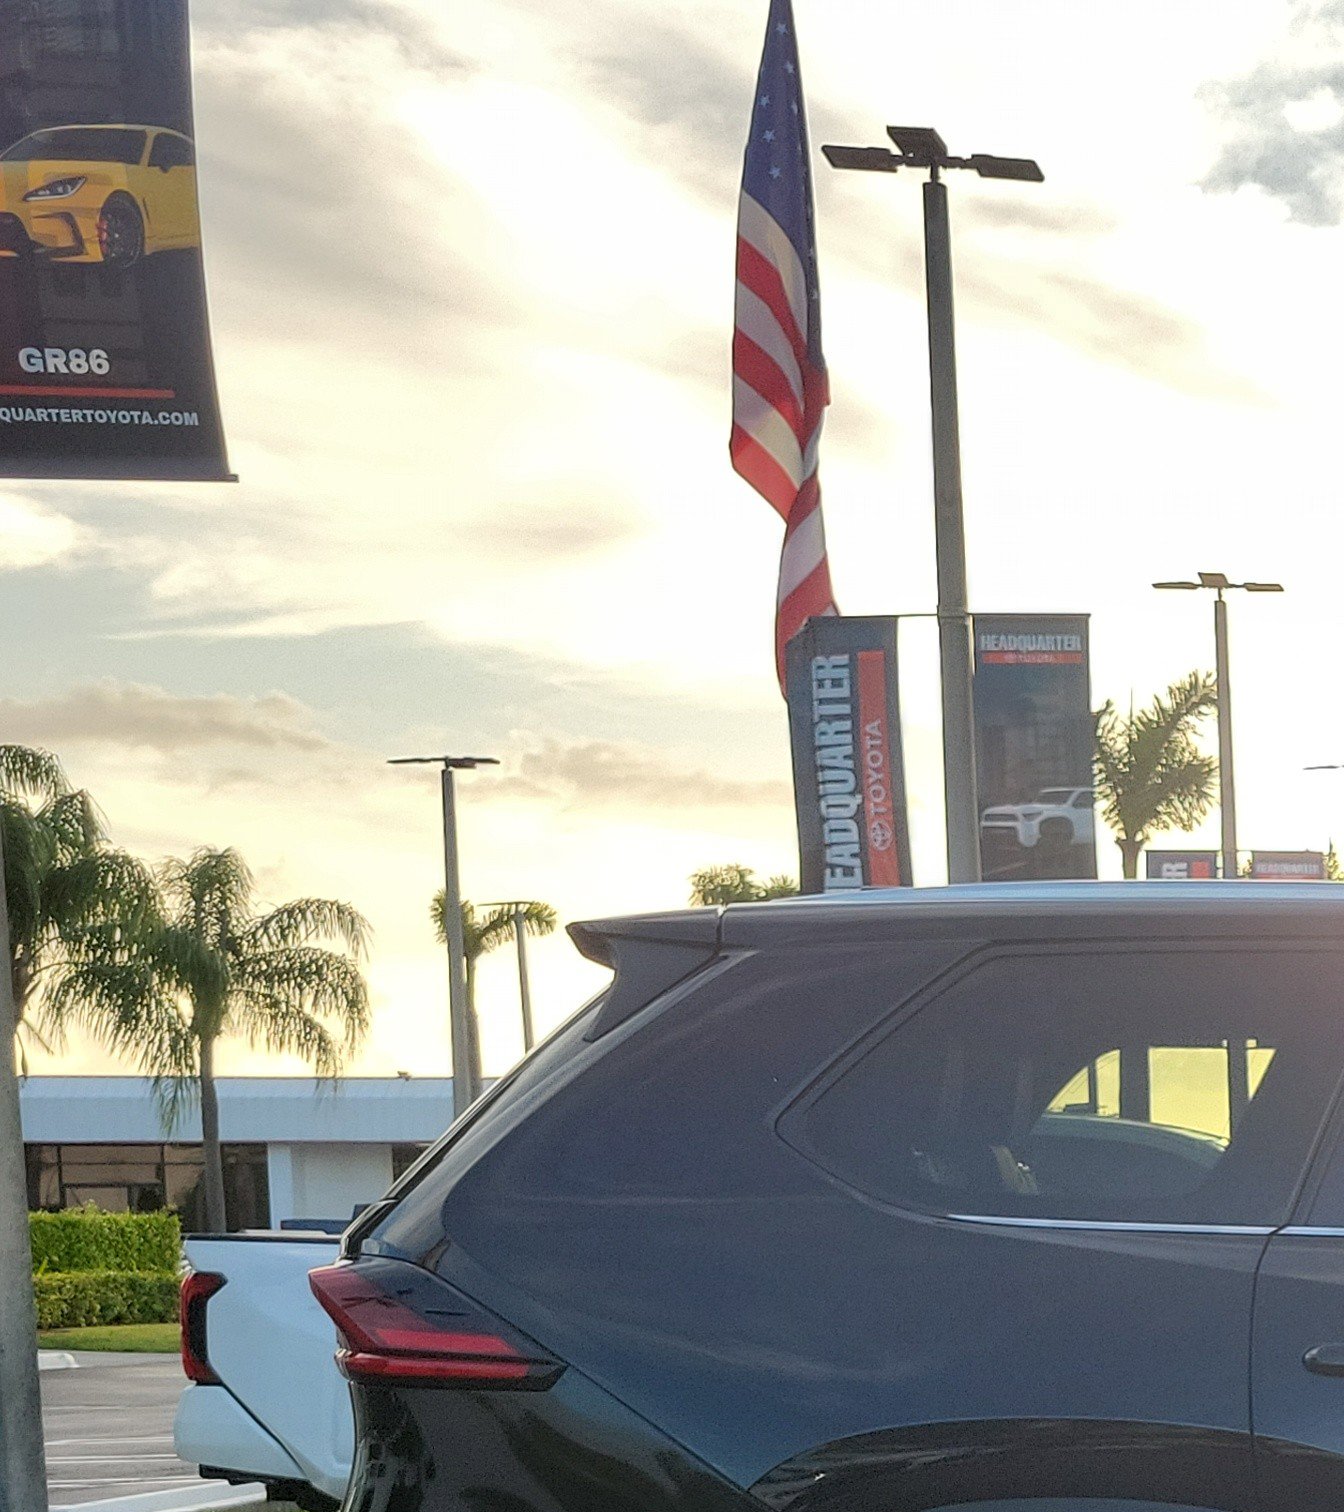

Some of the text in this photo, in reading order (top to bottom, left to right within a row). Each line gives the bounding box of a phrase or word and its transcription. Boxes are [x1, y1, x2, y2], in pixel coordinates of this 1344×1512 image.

[18, 347, 110, 375] GR86
[0, 407, 199, 426] QUARTERTOYOTA.COM
[811, 653, 863, 893] EADQUARTER
[865, 719, 888, 816] TOYOTA
